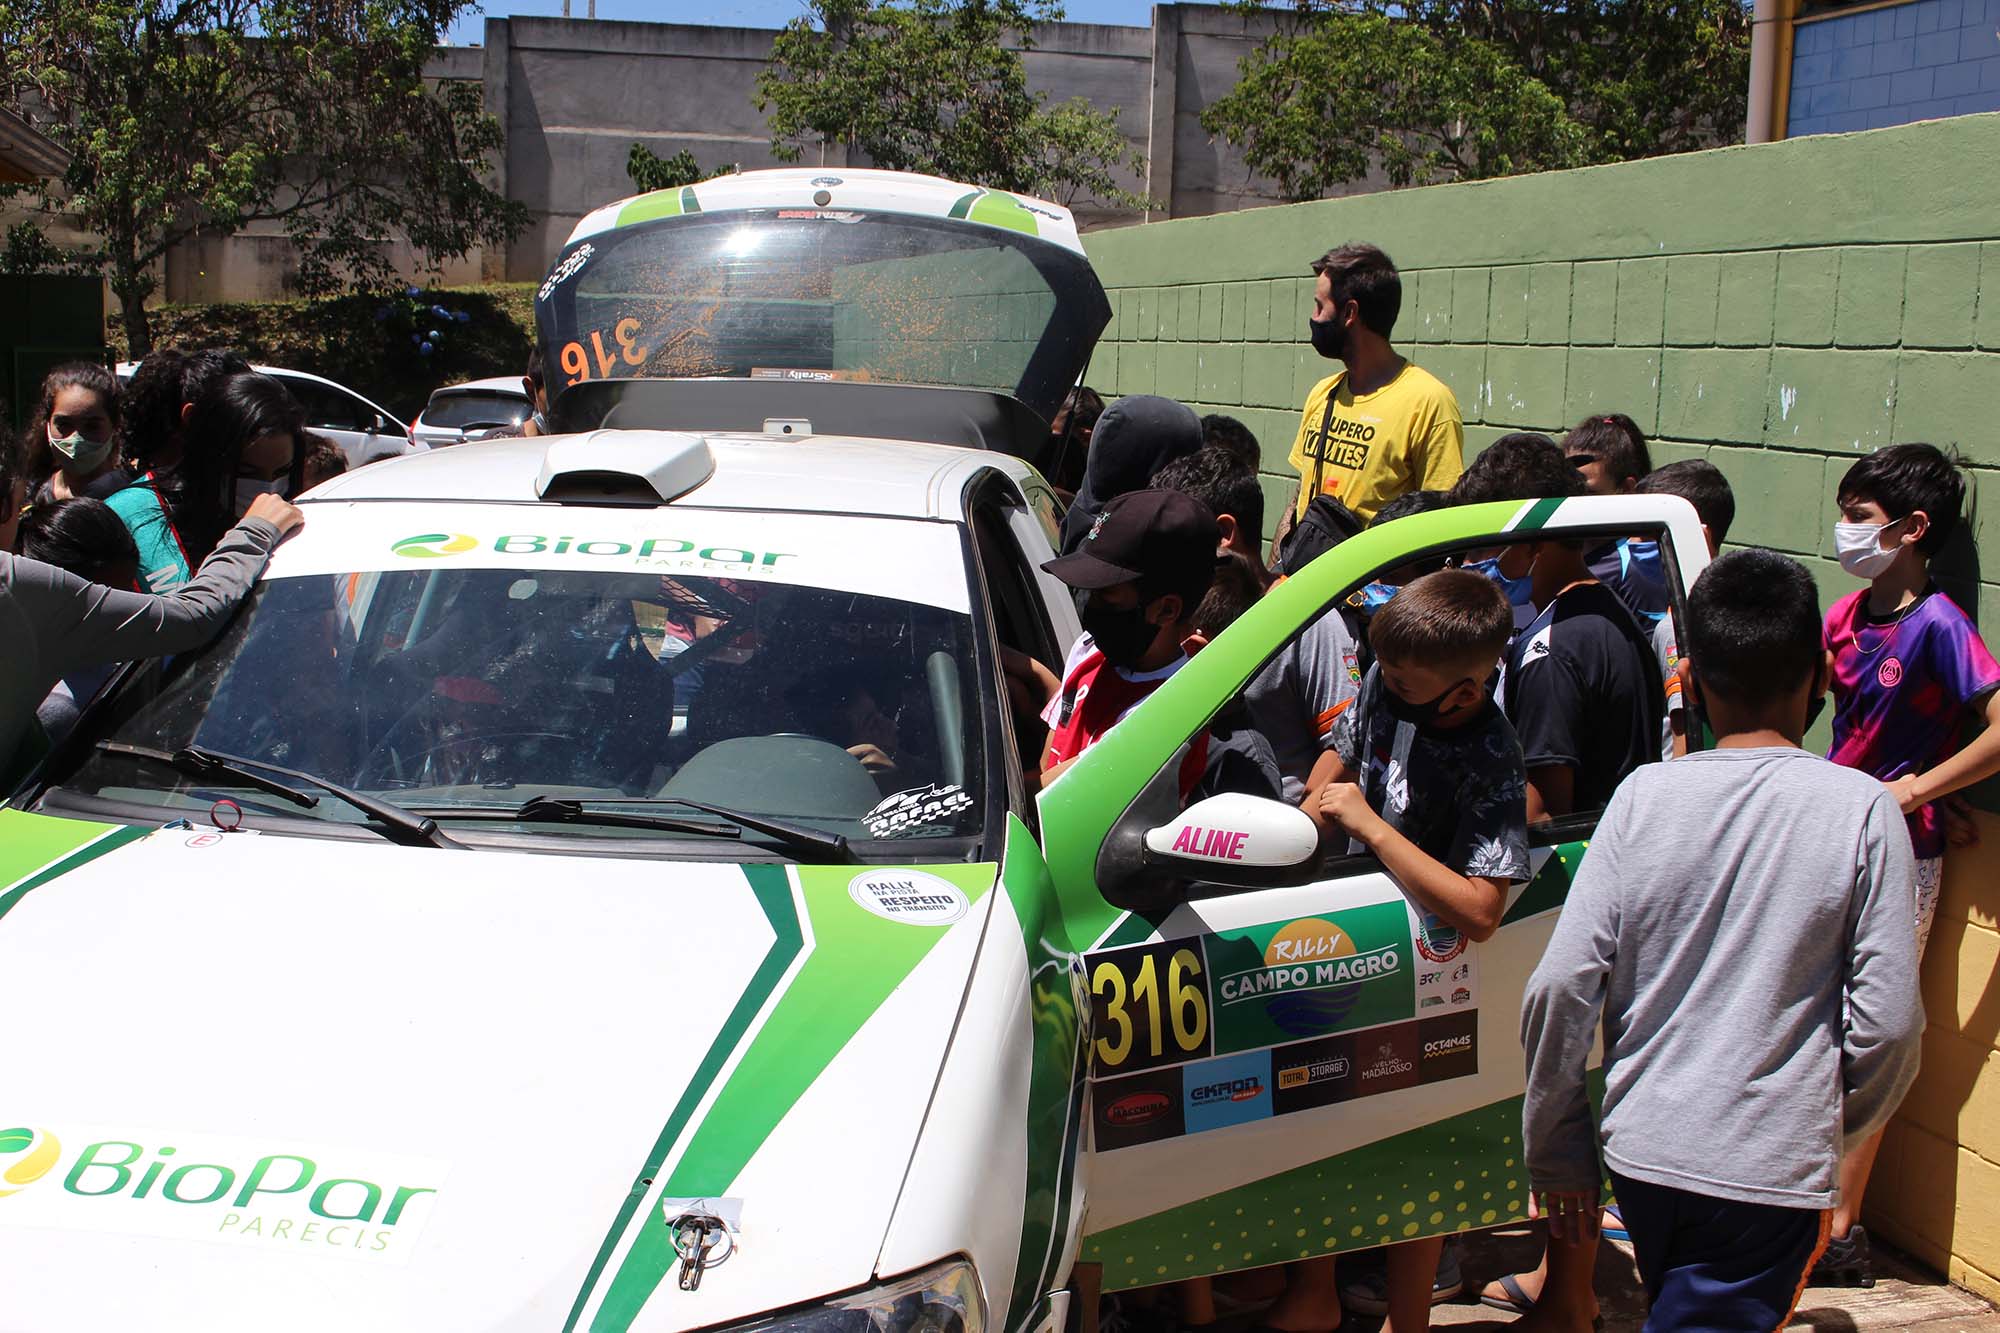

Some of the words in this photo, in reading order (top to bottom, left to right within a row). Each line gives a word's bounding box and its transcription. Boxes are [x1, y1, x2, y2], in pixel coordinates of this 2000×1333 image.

[561, 317, 648, 386] 316
[1328, 416, 1375, 442] UPERO
[494, 534, 798, 566] BioPar
[635, 558, 775, 574] PARECIS
[870, 792, 971, 833] RAFAEL
[1172, 825, 1249, 860] ALINE
[866, 881, 914, 891] RALLY
[890, 888, 920, 896] PISTA
[878, 895, 954, 907] RESPEITO
[1274, 933, 1342, 961] RALLY
[1220, 966, 1309, 1000] CAMPO
[1315, 950, 1399, 984] MAGRO
[1092, 948, 1208, 1066] 316
[1424, 1035, 1471, 1052] OCTANAS
[1283, 1071, 1305, 1084] TOTAL
[1311, 1061, 1344, 1078] STORAGE
[1362, 1062, 1412, 1080] MADALOSSO
[1375, 1058, 1400, 1068] VELHO
[64, 1141, 437, 1225] BioPar
[219, 1213, 391, 1252] PARECIS
